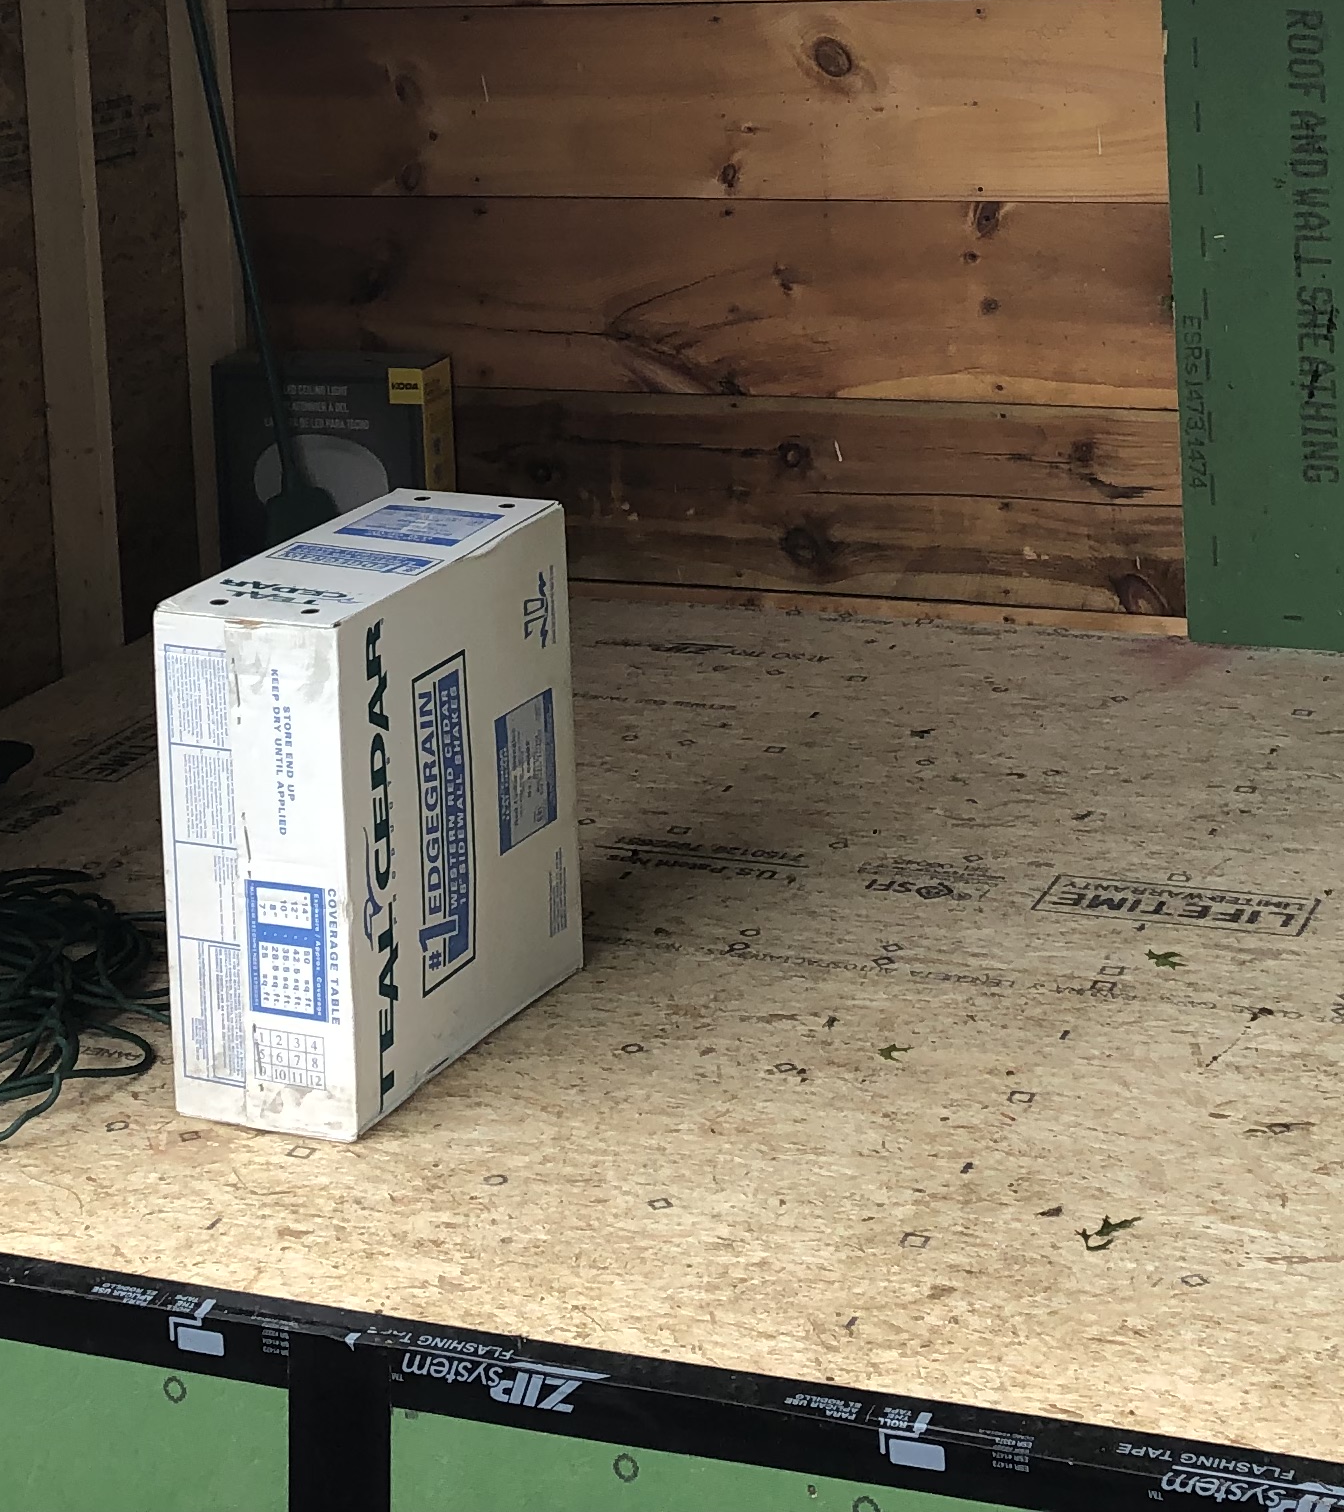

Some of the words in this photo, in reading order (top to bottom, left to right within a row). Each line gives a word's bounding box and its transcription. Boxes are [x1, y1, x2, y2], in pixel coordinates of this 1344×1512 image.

[1285, 9, 1327, 104] ROOF
[1290, 111, 1329, 178] AND
[1292, 188, 1332, 277] WALL
[1297, 285, 1340, 486] SHEATHING
[270, 668, 280, 701] KEEP
[273, 706, 281, 732] DRY
[283, 706, 293, 747] STORE
[274, 738, 283, 775] UNTIL
[286, 752, 294, 778] END
[366, 617, 391, 890] CEDAR
[277, 781, 287, 836] APPLIED
[287, 784, 296, 802] UP
[418, 691, 443, 917] EDGEGRAIN
[1051, 891, 1296, 928] LIFETIME
[1064, 881, 1205, 901] WARRANTY
[328, 888, 338, 971] COVERAGE
[331, 978, 340, 1025] TABLE
[378, 901, 399, 1114] TEAL
[275, 1069, 286, 1080] 10
[292, 1072, 303, 1083] 11
[310, 1075, 322, 1086] 12
[416, 1334, 514, 1360] FLASHING
[825, 1409, 857, 1420] PARA
[1116, 1442, 1173, 1462] TAPE
[1179, 1452, 1296, 1480] FLASHING
